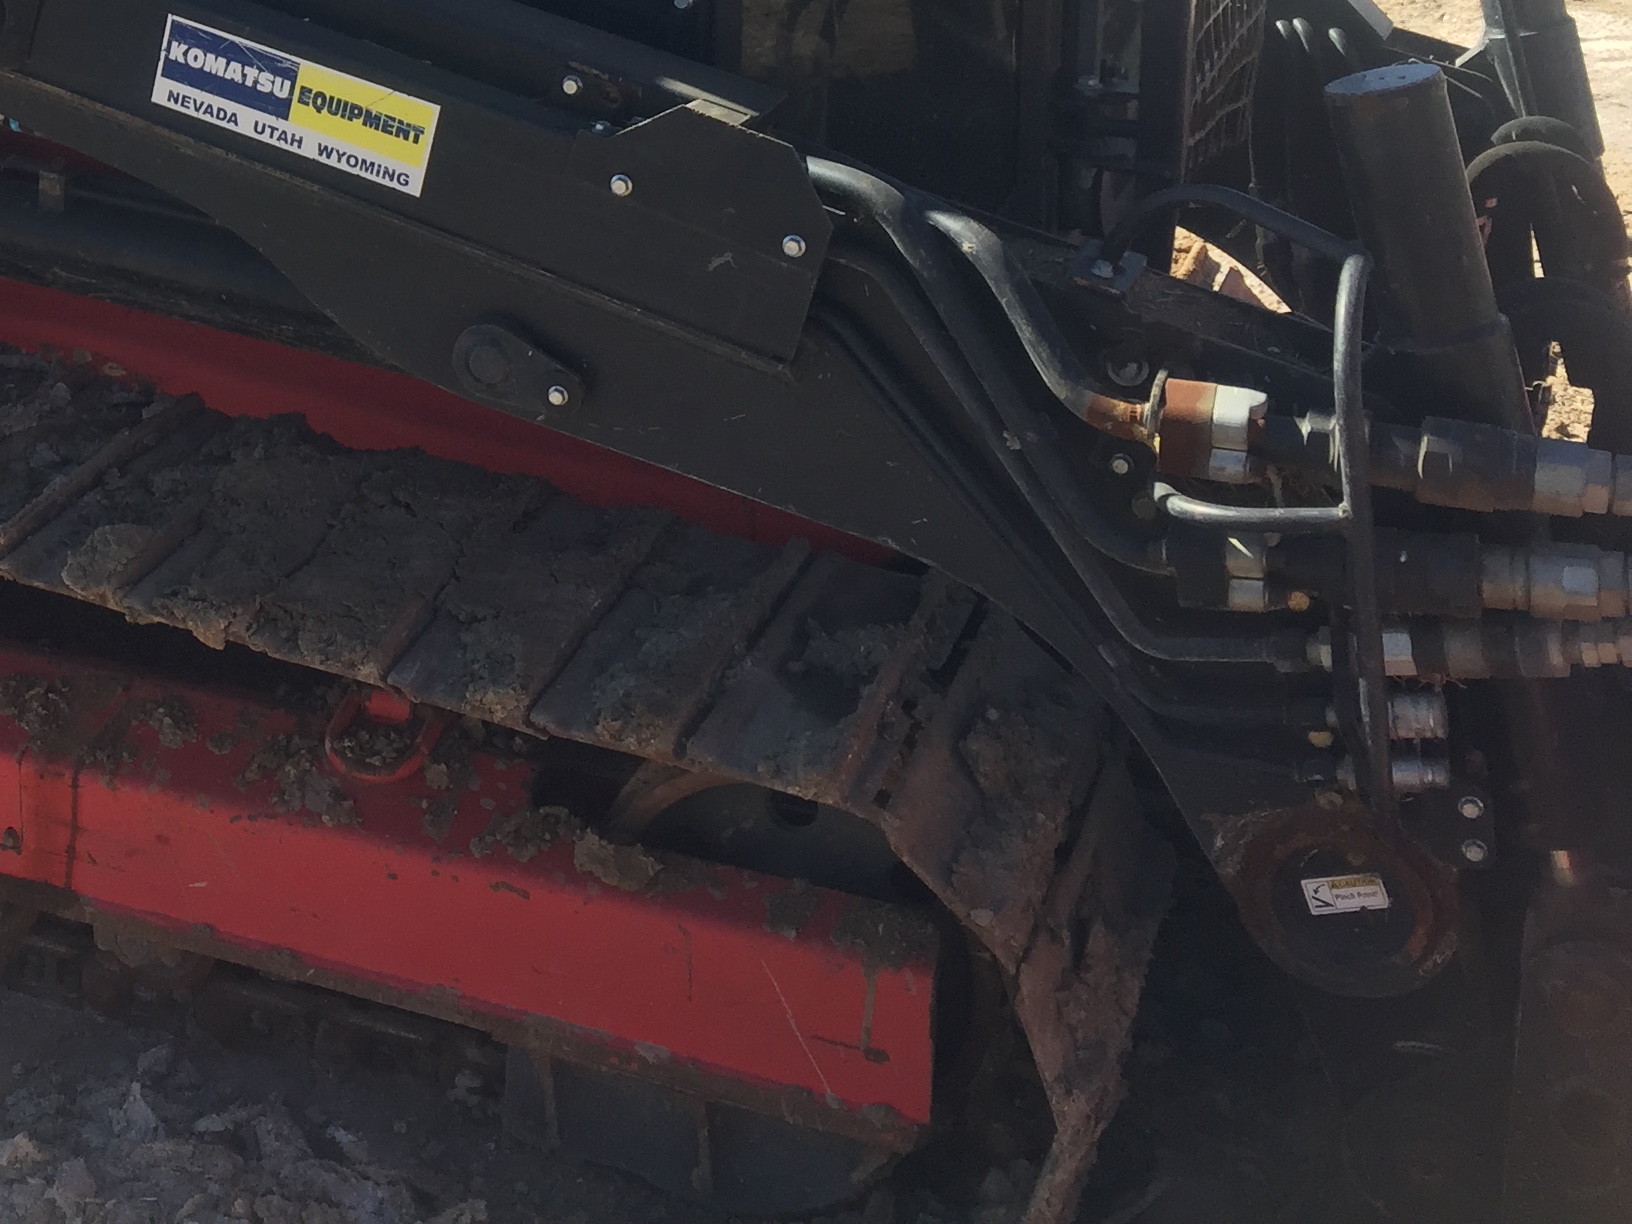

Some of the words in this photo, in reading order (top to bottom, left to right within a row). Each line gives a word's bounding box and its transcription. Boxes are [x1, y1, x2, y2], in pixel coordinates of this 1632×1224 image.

[166, 88, 240, 128] NEVADA
[253, 119, 304, 150] UTAH
[316, 142, 411, 188] WYOMING
[168, 40, 292, 100] KOMATSU
[297, 85, 425, 145] EQUIPMENT
